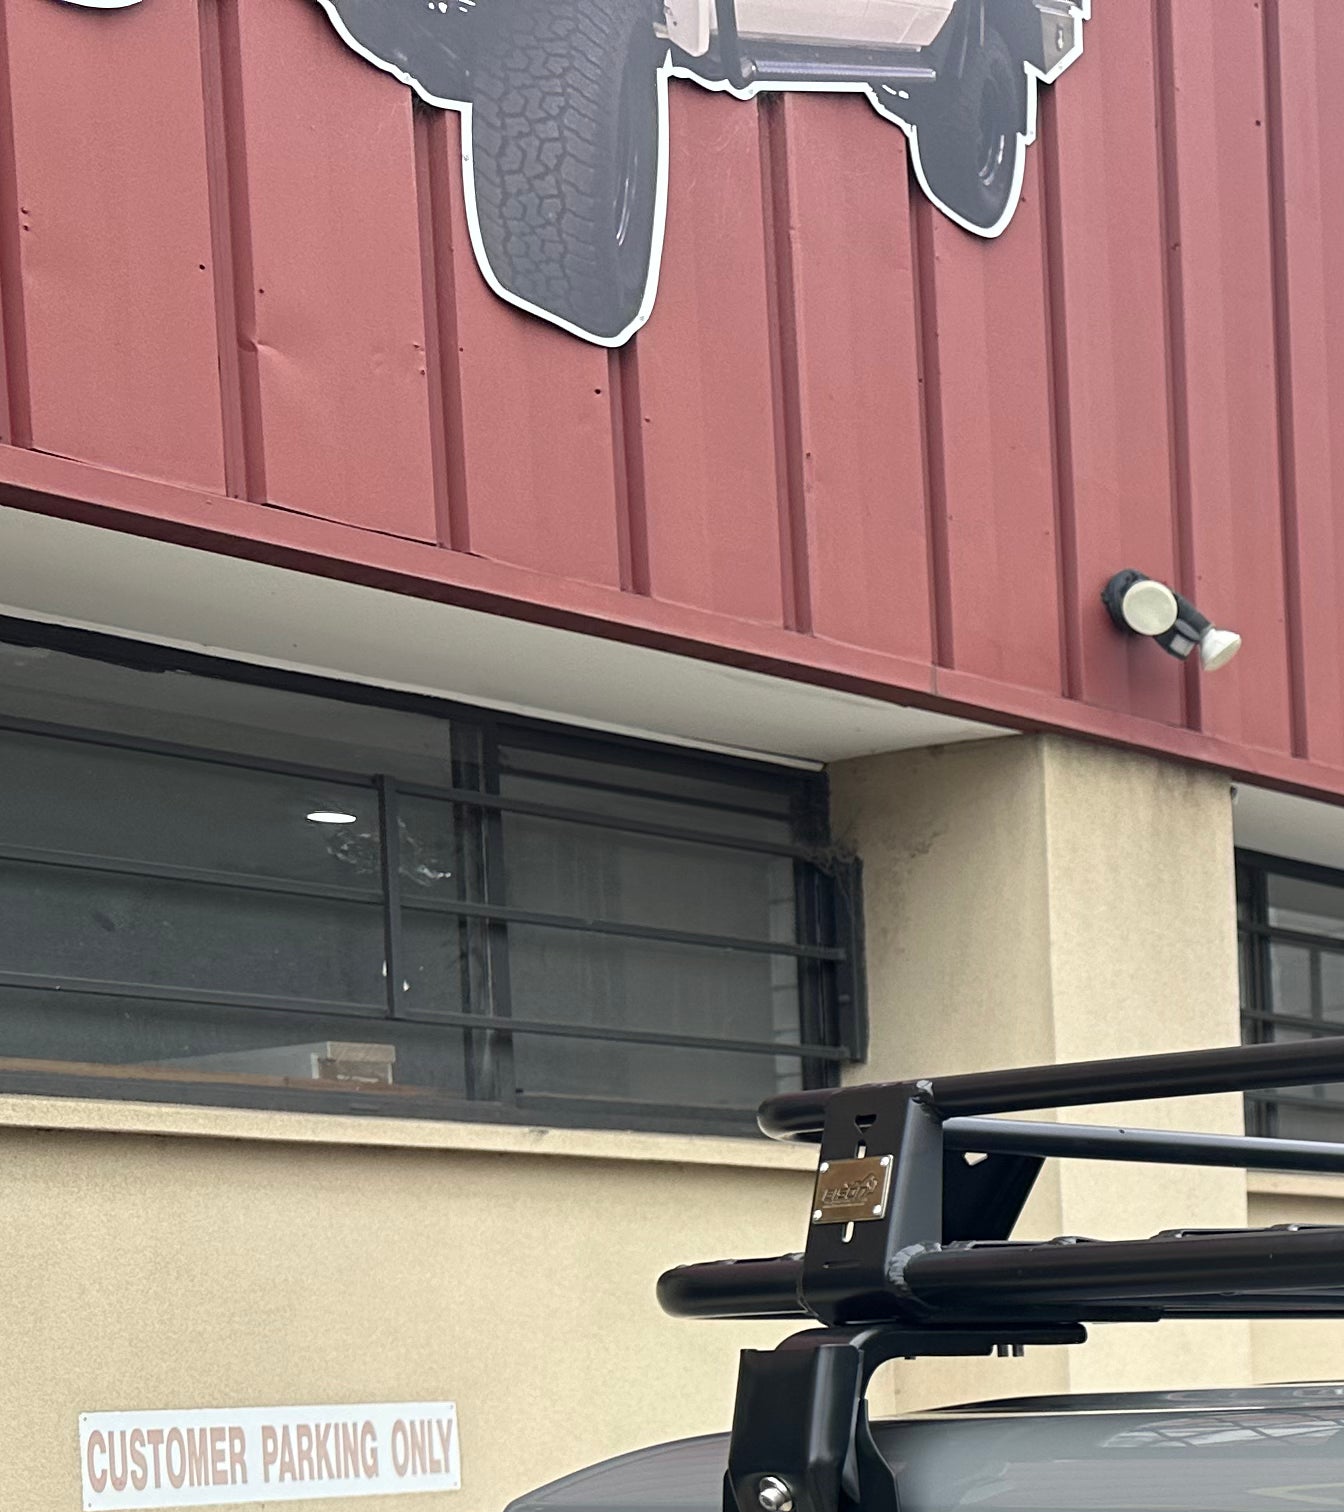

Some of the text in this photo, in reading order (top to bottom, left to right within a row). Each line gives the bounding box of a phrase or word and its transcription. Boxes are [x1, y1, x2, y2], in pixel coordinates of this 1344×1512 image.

[86, 1418, 454, 1494] CUSTOMER PARKING ONLY
